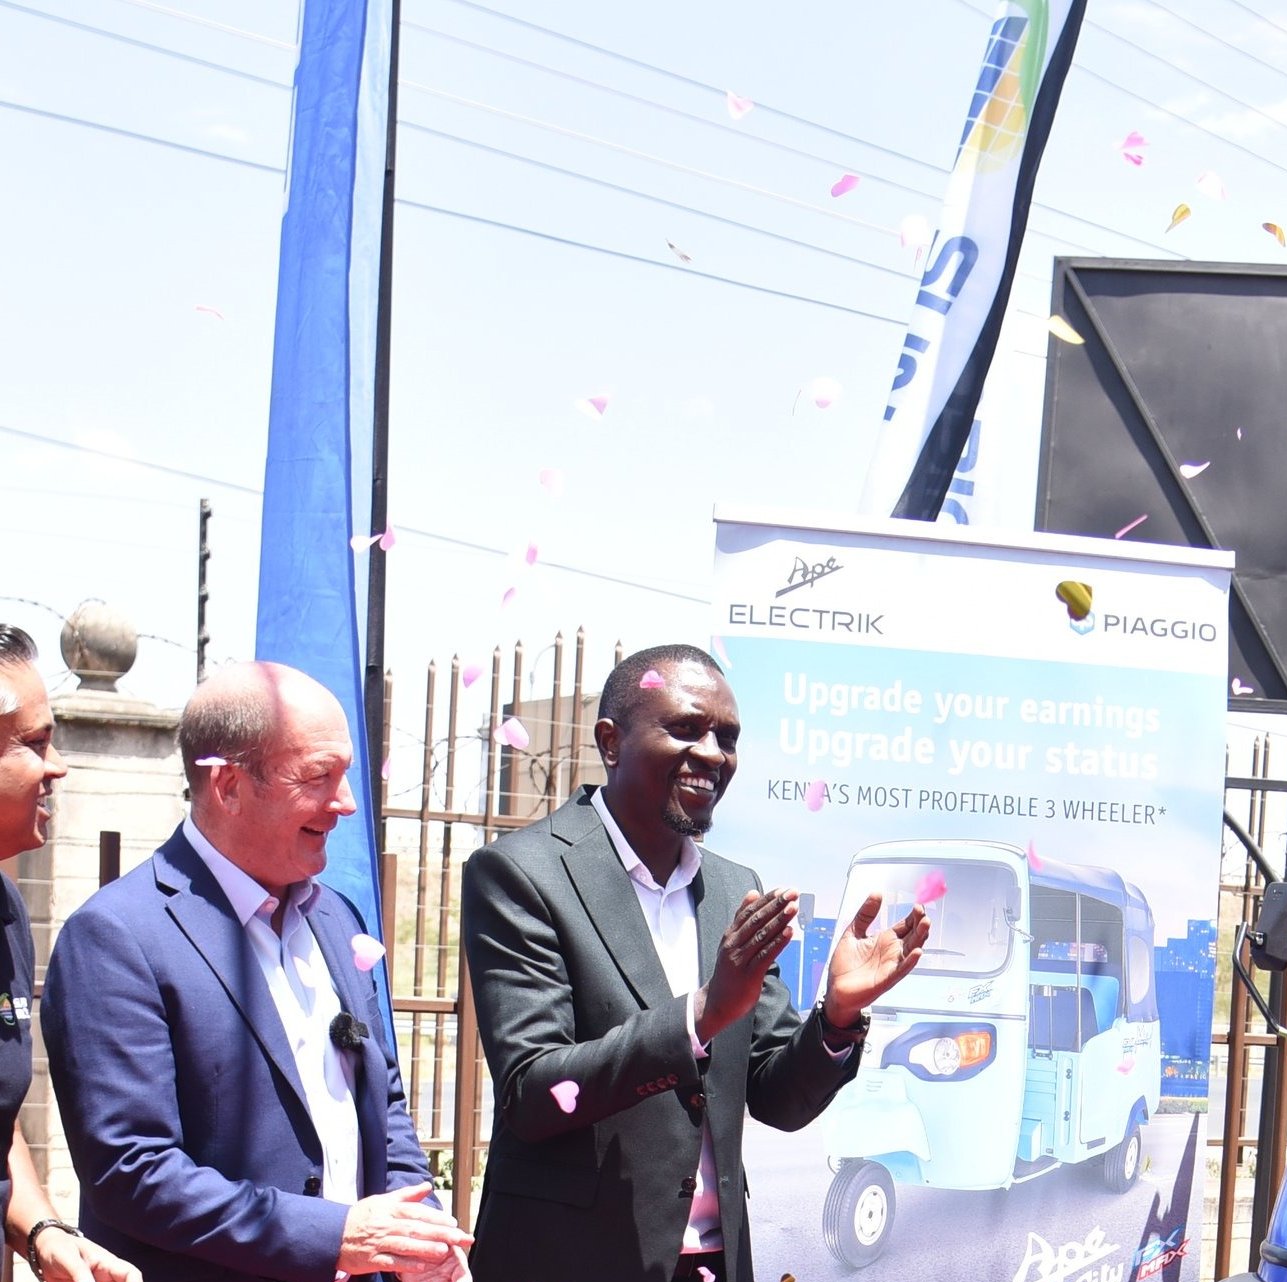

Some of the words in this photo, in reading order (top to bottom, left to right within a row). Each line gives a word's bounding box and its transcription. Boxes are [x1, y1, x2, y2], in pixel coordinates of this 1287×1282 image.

[728, 603, 885, 635] ELECTRIK
[1104, 613, 1217, 642] PIAGGIO
[784, 672, 923, 717] Upgrade
[934, 690, 1010, 725] your
[1020, 695, 1160, 739] earnings
[779, 718, 935, 768] Upgrade
[947, 738, 1032, 776] your
[1045, 746, 1160, 781] status
[767, 779, 850, 806] KENA'S
[857, 786, 913, 809] MOST
[918, 789, 1039, 818] PROFITABLE
[1045, 799, 1056, 819] 3
